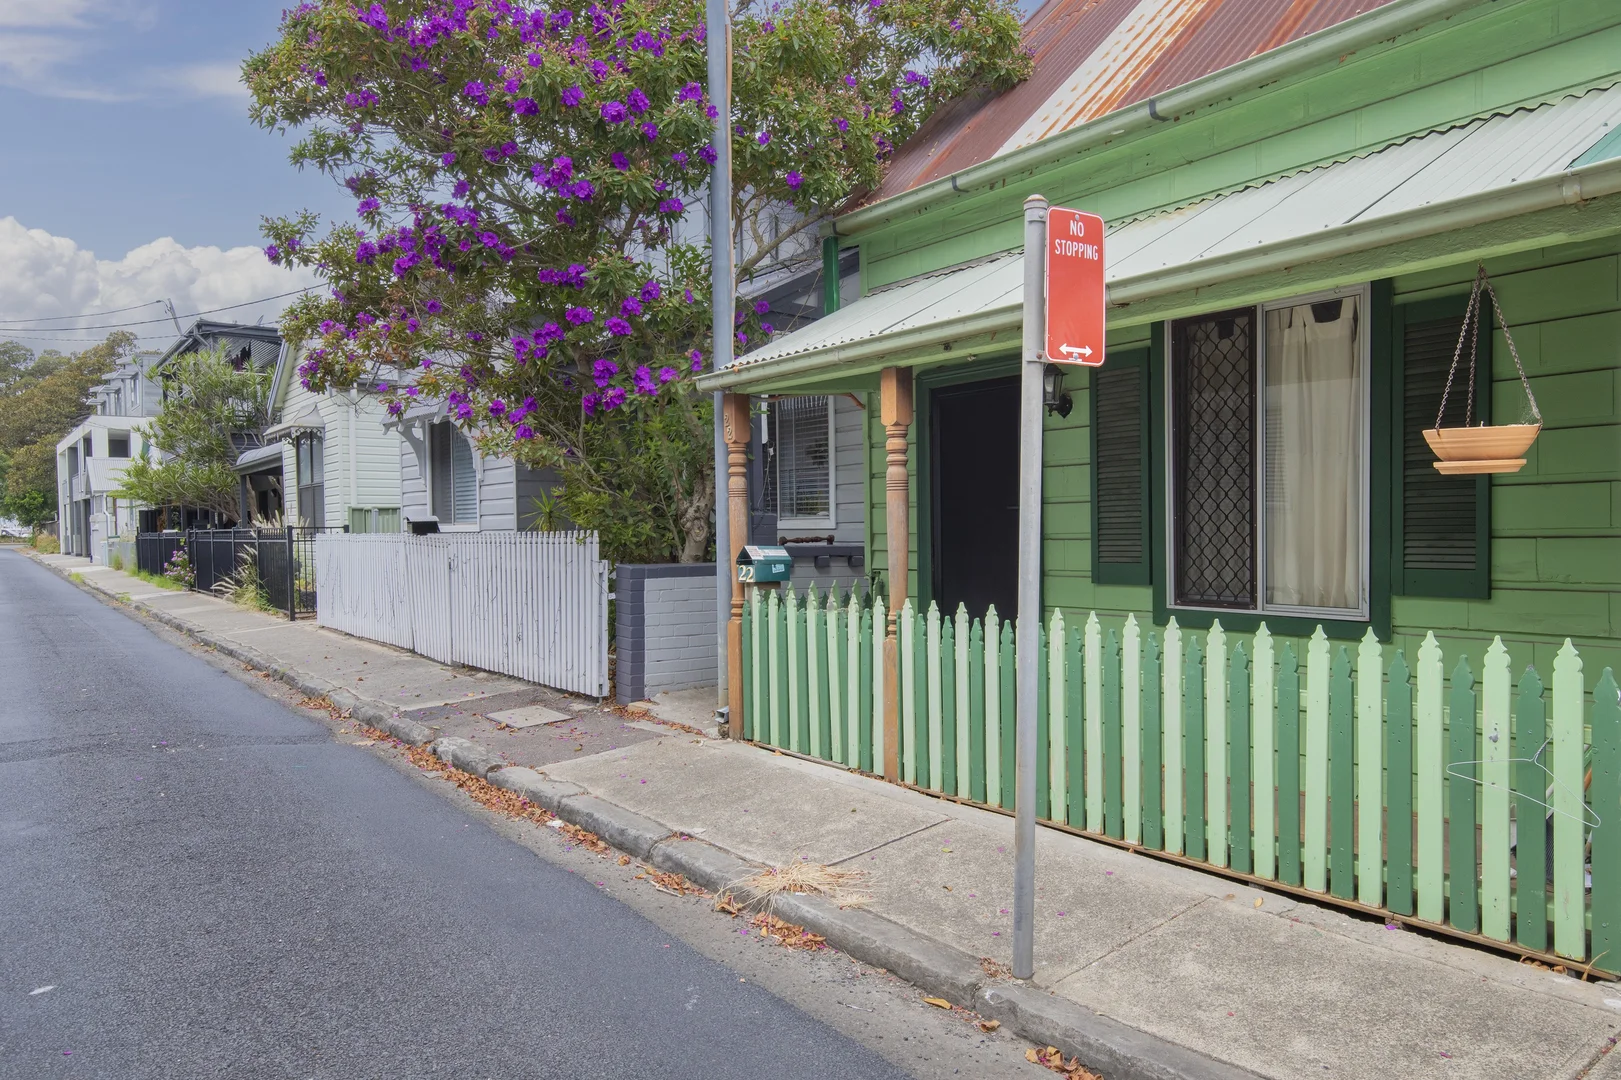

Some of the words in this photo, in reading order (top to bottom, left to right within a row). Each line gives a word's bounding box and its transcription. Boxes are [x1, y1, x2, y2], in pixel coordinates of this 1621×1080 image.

[1070, 219, 1084, 237] NO
[1054, 238, 1099, 260] STOPPING
[739, 564, 754, 582] 22
